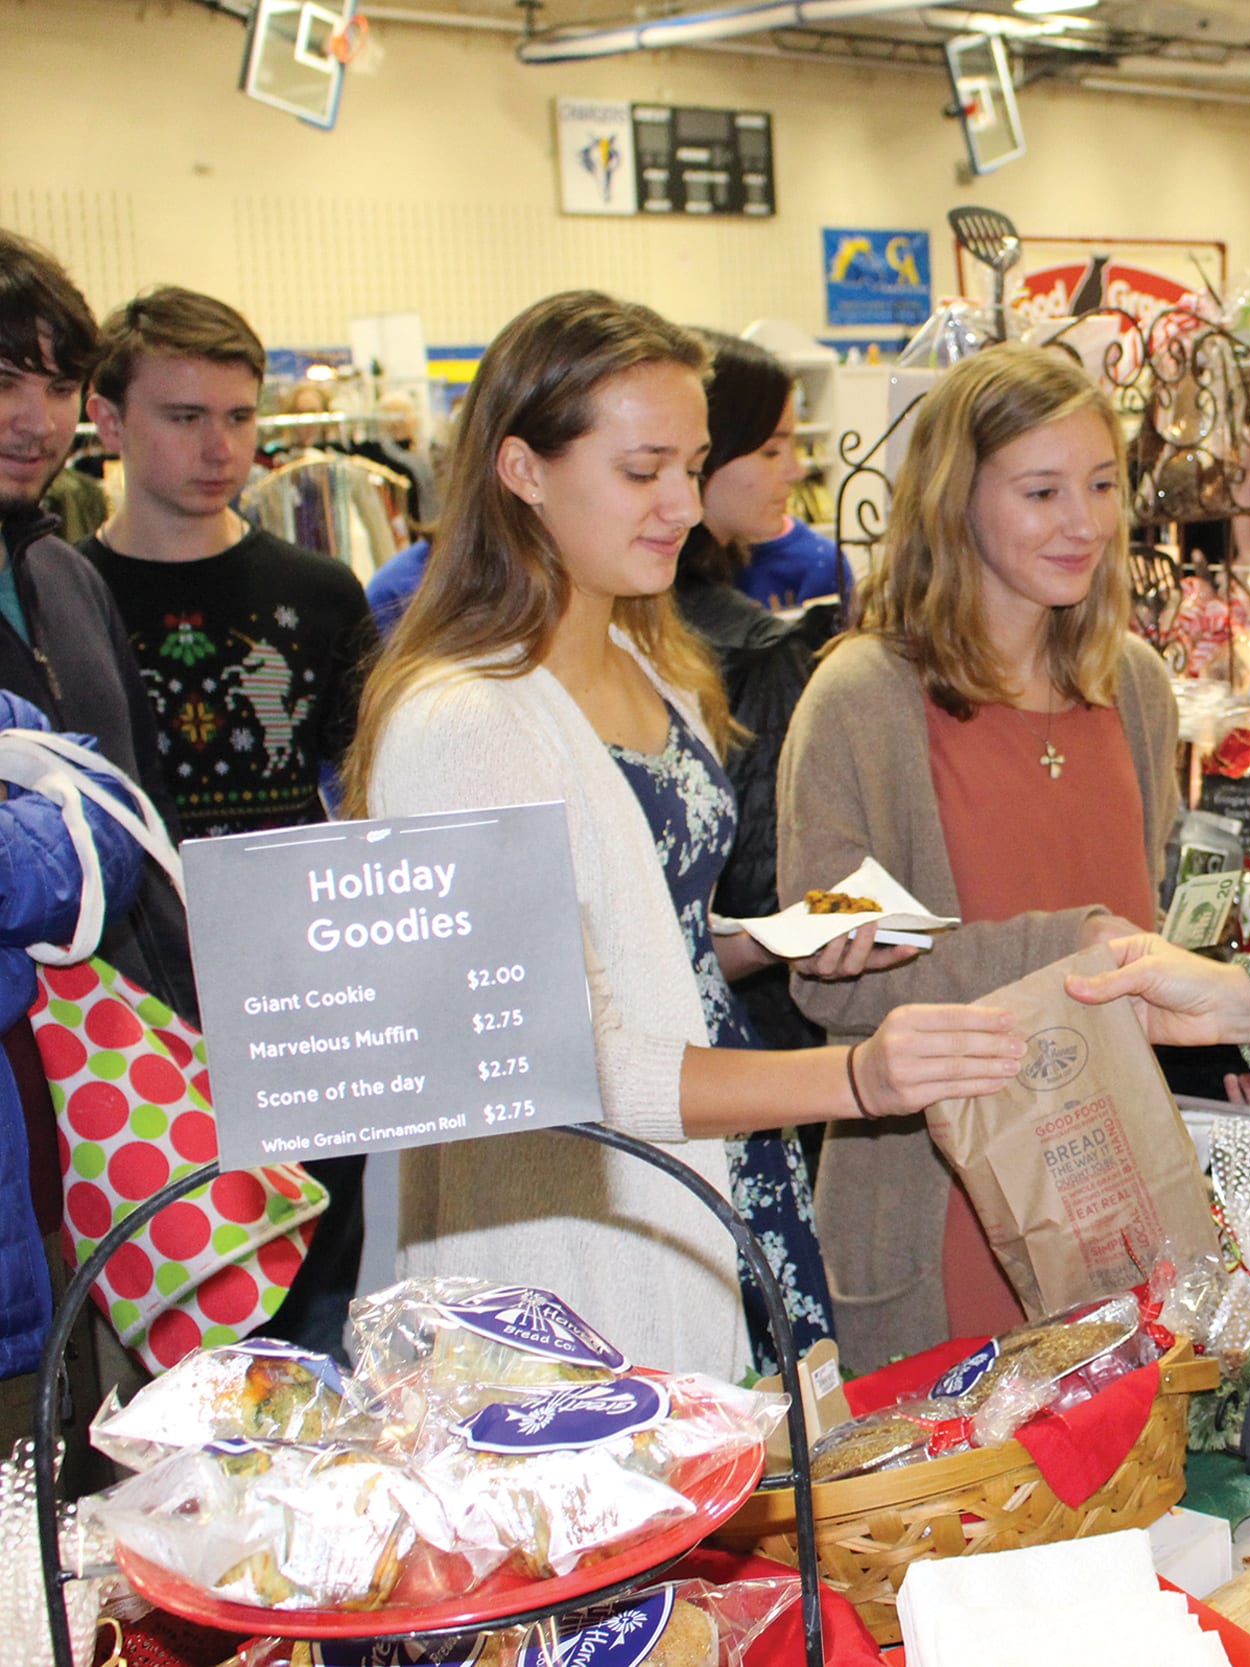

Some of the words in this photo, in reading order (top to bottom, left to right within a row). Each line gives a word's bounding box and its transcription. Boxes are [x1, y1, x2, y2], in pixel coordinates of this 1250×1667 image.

[308, 859, 456, 902] Holiday
[1216, 879, 1233, 899] 20
[307, 908, 472, 952] Goodies
[244, 993, 300, 1015] Giant
[304, 985, 376, 1007] Cookie
[466, 964, 525, 990] $2.00
[249, 1033, 350, 1060] Marvelous
[355, 1025, 419, 1048] Muffin
[472, 1009, 524, 1034] $2.75
[256, 1088, 319, 1108] Scone
[325, 1081, 347, 1100] of
[351, 1078, 385, 1097] the
[390, 1073, 426, 1093] day
[478, 1056, 530, 1082] $2.75
[262, 1136, 310, 1153] Whole
[314, 1130, 356, 1148] Grain
[359, 1120, 436, 1142] Cinnamon
[439, 1113, 467, 1130] Roll
[483, 1099, 536, 1124] $2.75
[1035, 1114, 1072, 1137] GOOD
[1075, 1097, 1107, 1119] FOOD
[1104, 1118, 1124, 1155] HAND
[1044, 1127, 1106, 1167] BREAD
[1051, 1161, 1074, 1178] THE
[1074, 1151, 1099, 1168] WAY
[1076, 1202, 1099, 1219] EAT
[1101, 1190, 1131, 1208] REAL
[503, 1326, 550, 1344] Bread
